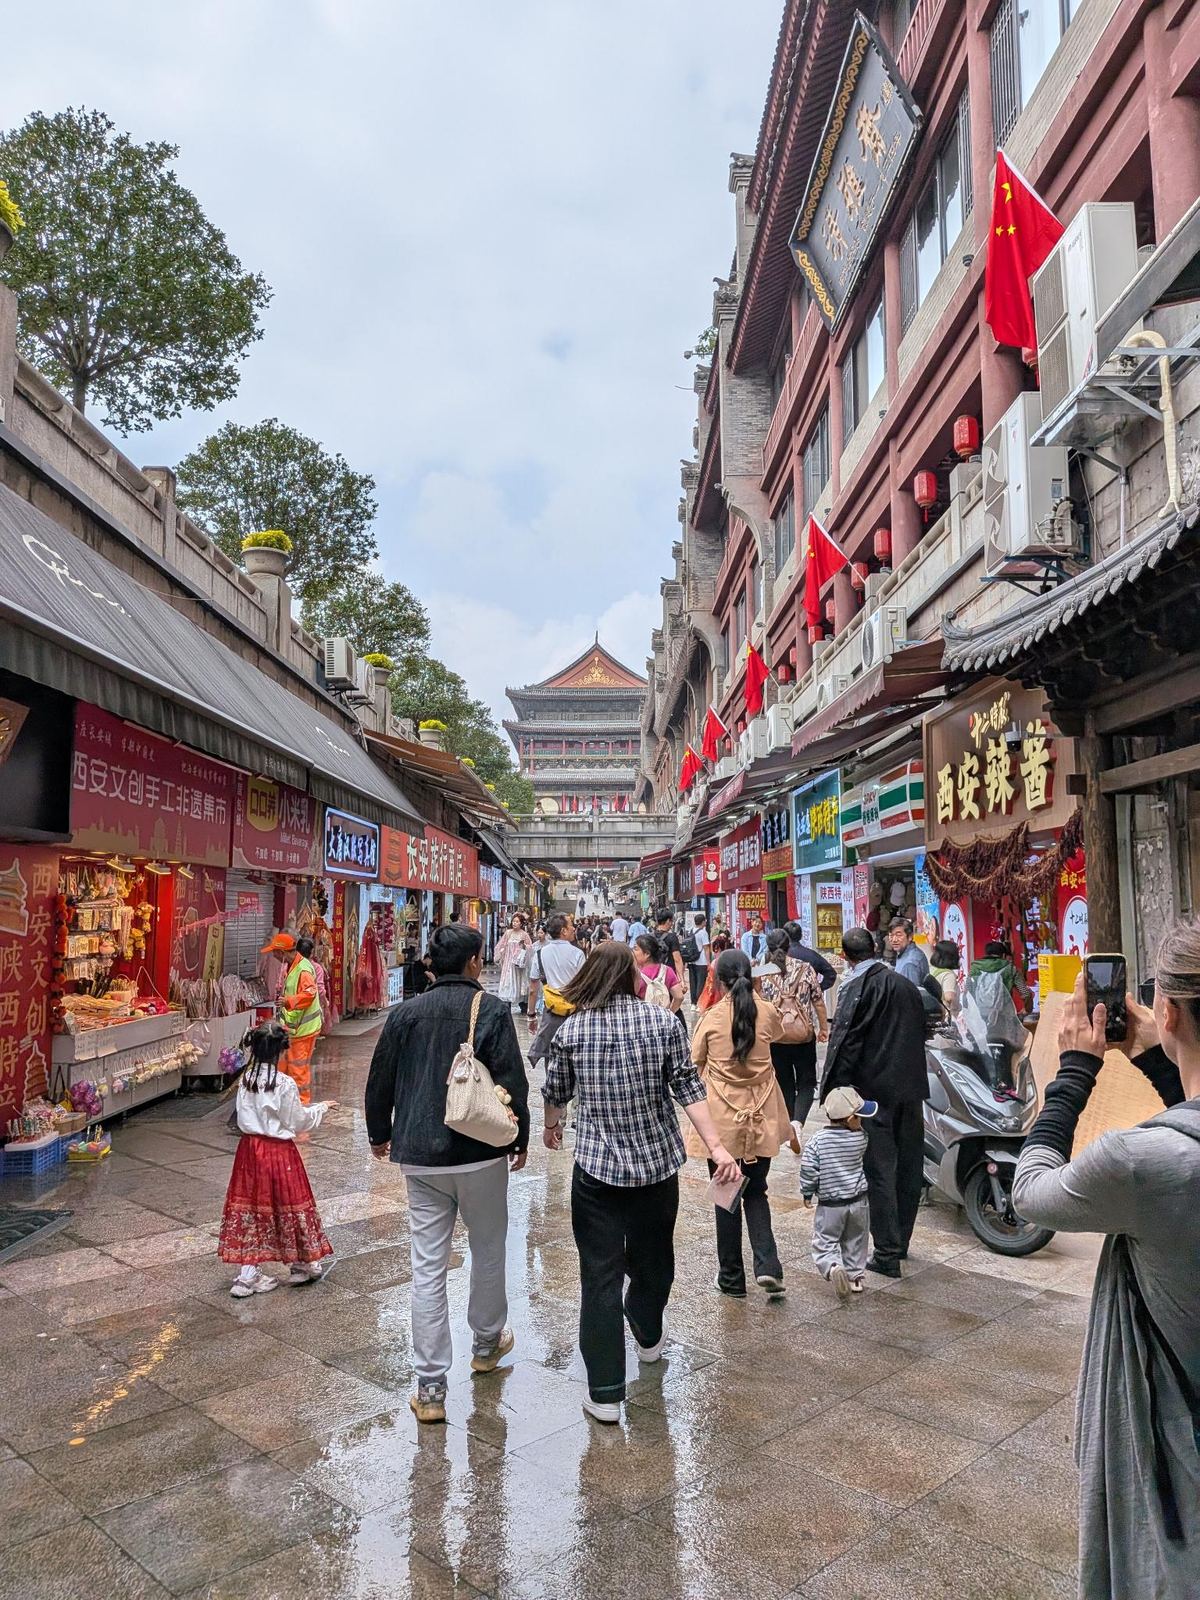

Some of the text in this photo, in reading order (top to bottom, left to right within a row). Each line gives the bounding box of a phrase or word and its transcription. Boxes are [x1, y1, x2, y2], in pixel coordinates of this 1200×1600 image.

[73, 751, 226, 825] 西安文创手工非遗集市
[279, 791, 310, 834] 小米乳
[739, 894, 766, 908] 全店20元
[24, 863, 51, 1037] 西安文创
